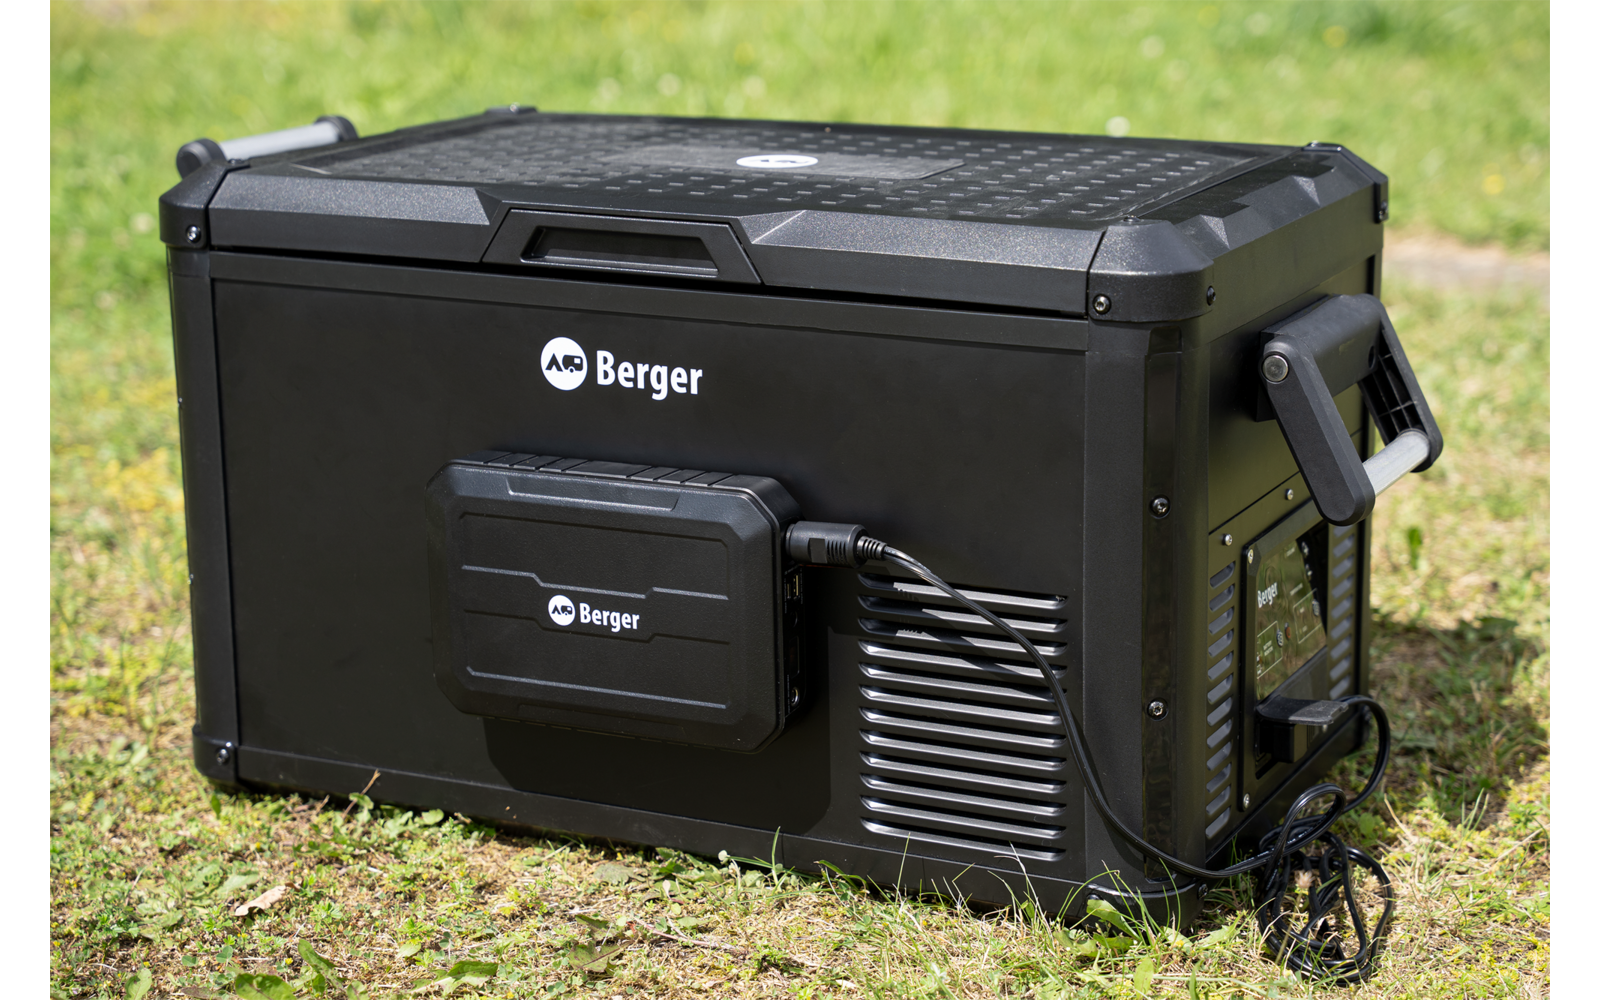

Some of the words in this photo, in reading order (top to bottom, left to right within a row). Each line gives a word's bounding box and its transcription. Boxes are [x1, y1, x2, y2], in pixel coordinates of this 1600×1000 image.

[596, 350, 703, 400] Berger
[1257, 582, 1278, 608] Berger
[579, 602, 640, 633] Berger
